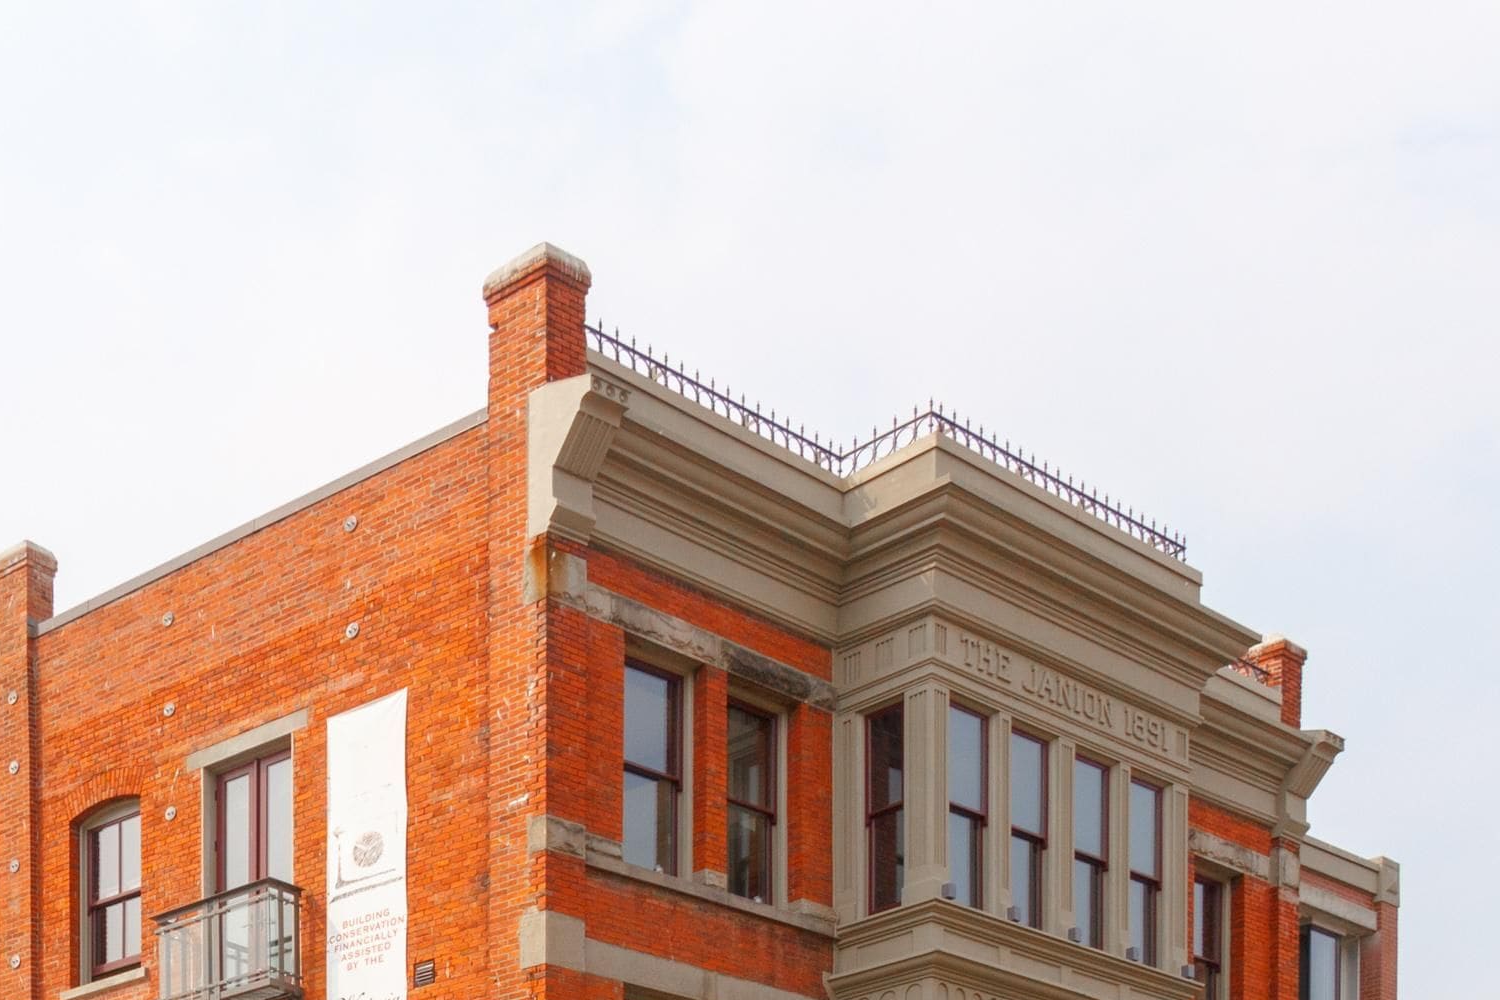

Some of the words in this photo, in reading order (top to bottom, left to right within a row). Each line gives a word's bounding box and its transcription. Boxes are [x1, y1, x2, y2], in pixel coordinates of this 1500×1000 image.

[960, 635, 1011, 684] THE
[1021, 664, 1112, 729] JANION
[1123, 706, 1169, 752] 1891
[328, 915, 405, 945] CONSERVATION
[342, 907, 390, 930] BUILDING
[334, 928, 398, 953] FINANCIALLY
[340, 941, 392, 962] ASSISTED
[346, 961, 358, 972] BY
[364, 953, 385, 967] THE
